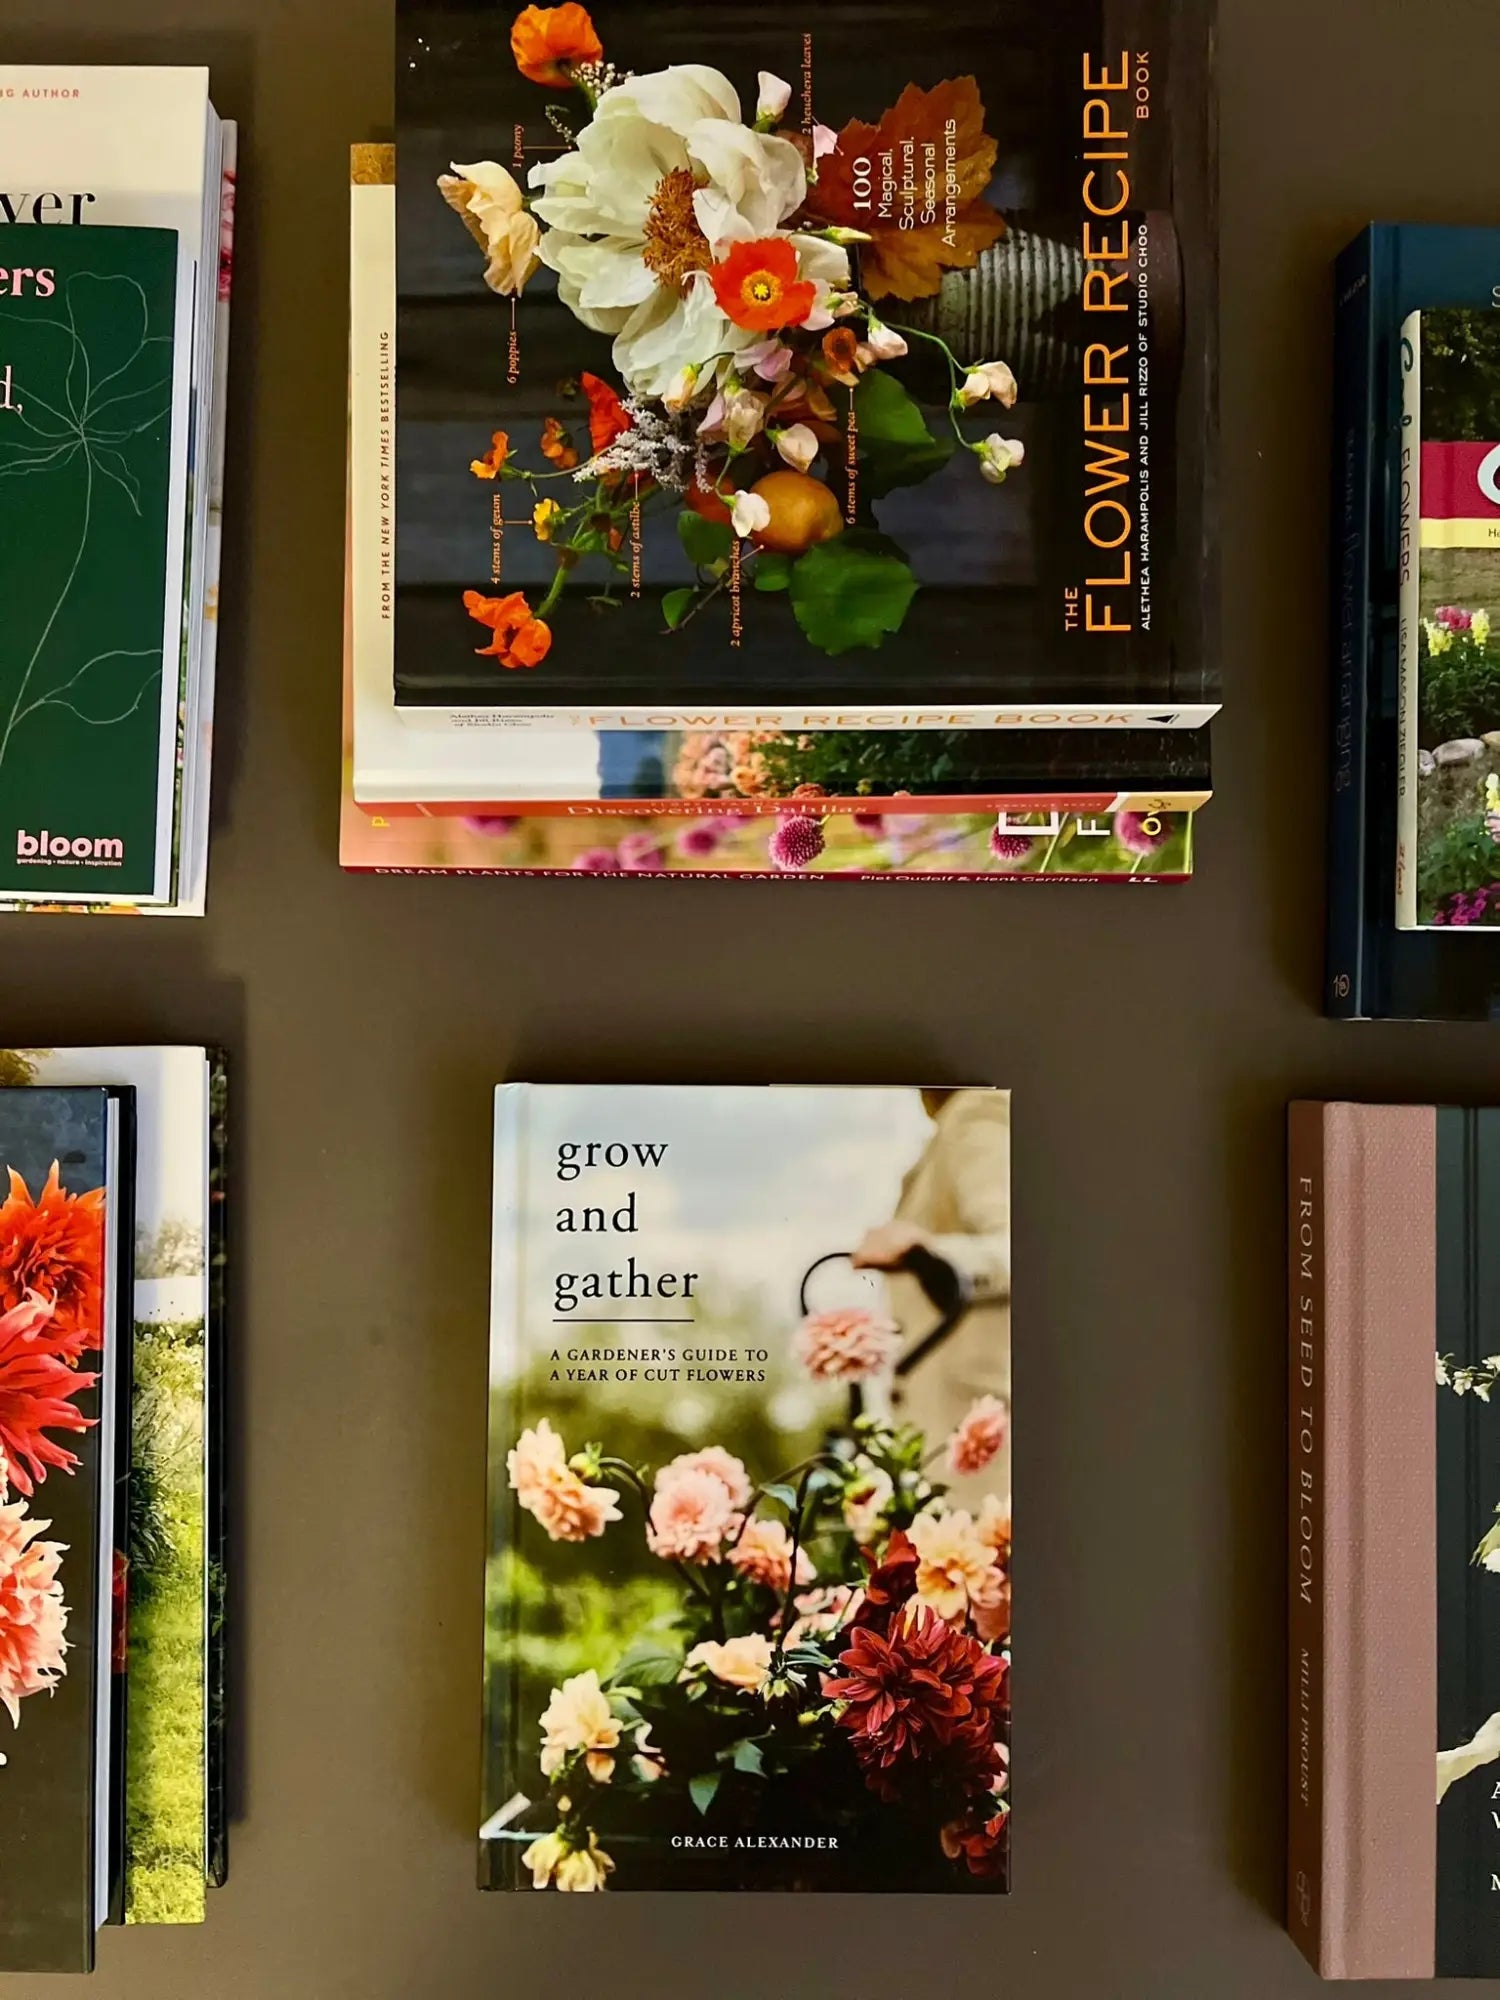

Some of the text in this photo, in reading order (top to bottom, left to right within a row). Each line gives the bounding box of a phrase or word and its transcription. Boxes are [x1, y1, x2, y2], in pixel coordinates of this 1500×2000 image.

[801, 33, 812, 67] leaves
[22, 88, 80, 98] AUTHOR
[801, 71, 812, 125] heuchera
[1136, 51, 1150, 119] BOOK
[512, 124, 525, 160] peony
[852, 157, 872, 210] 100
[921, 143, 936, 223] Seasonal
[942, 118, 961, 247] Arrangements
[507, 331, 520, 375] poppies
[1082, 51, 1132, 632] FLOWER RECIPE
[848, 411, 858, 433] pea
[1138, 225, 1151, 631] ALETHEA HARAMPOLIS AND JILL RIZZO OF STUDIO CHOO
[847, 434, 857, 464] sweet
[380, 331, 390, 619] FROM THE NEW YORK TIMES BESTSELLING
[844, 465, 859, 480] of
[846, 481, 856, 514] stems
[490, 494, 504, 585] 4 stems of geum
[629, 501, 643, 598] 2 stems of astilbe
[730, 540, 743, 647] 2 apricot branches
[1065, 587, 1078, 632] THE
[589, 713, 1133, 726] FLOWER RECIPE BOOK
[17, 829, 124, 859] bloom
[556, 1142, 669, 1181] grow
[556, 1191, 638, 1233] and
[554, 1257, 699, 1312] gather
[550, 1348, 769, 1362] A GARDENER'S GUIDE TO
[550, 1369, 766, 1382] A YEAR OF CUT FLOWERS
[1300, 1177, 1313, 1604] FROM SEED TO BLOOM
[1300, 1716, 1310, 1806] PROUST
[670, 1835, 839, 1849] GRACE ALEXANDER
